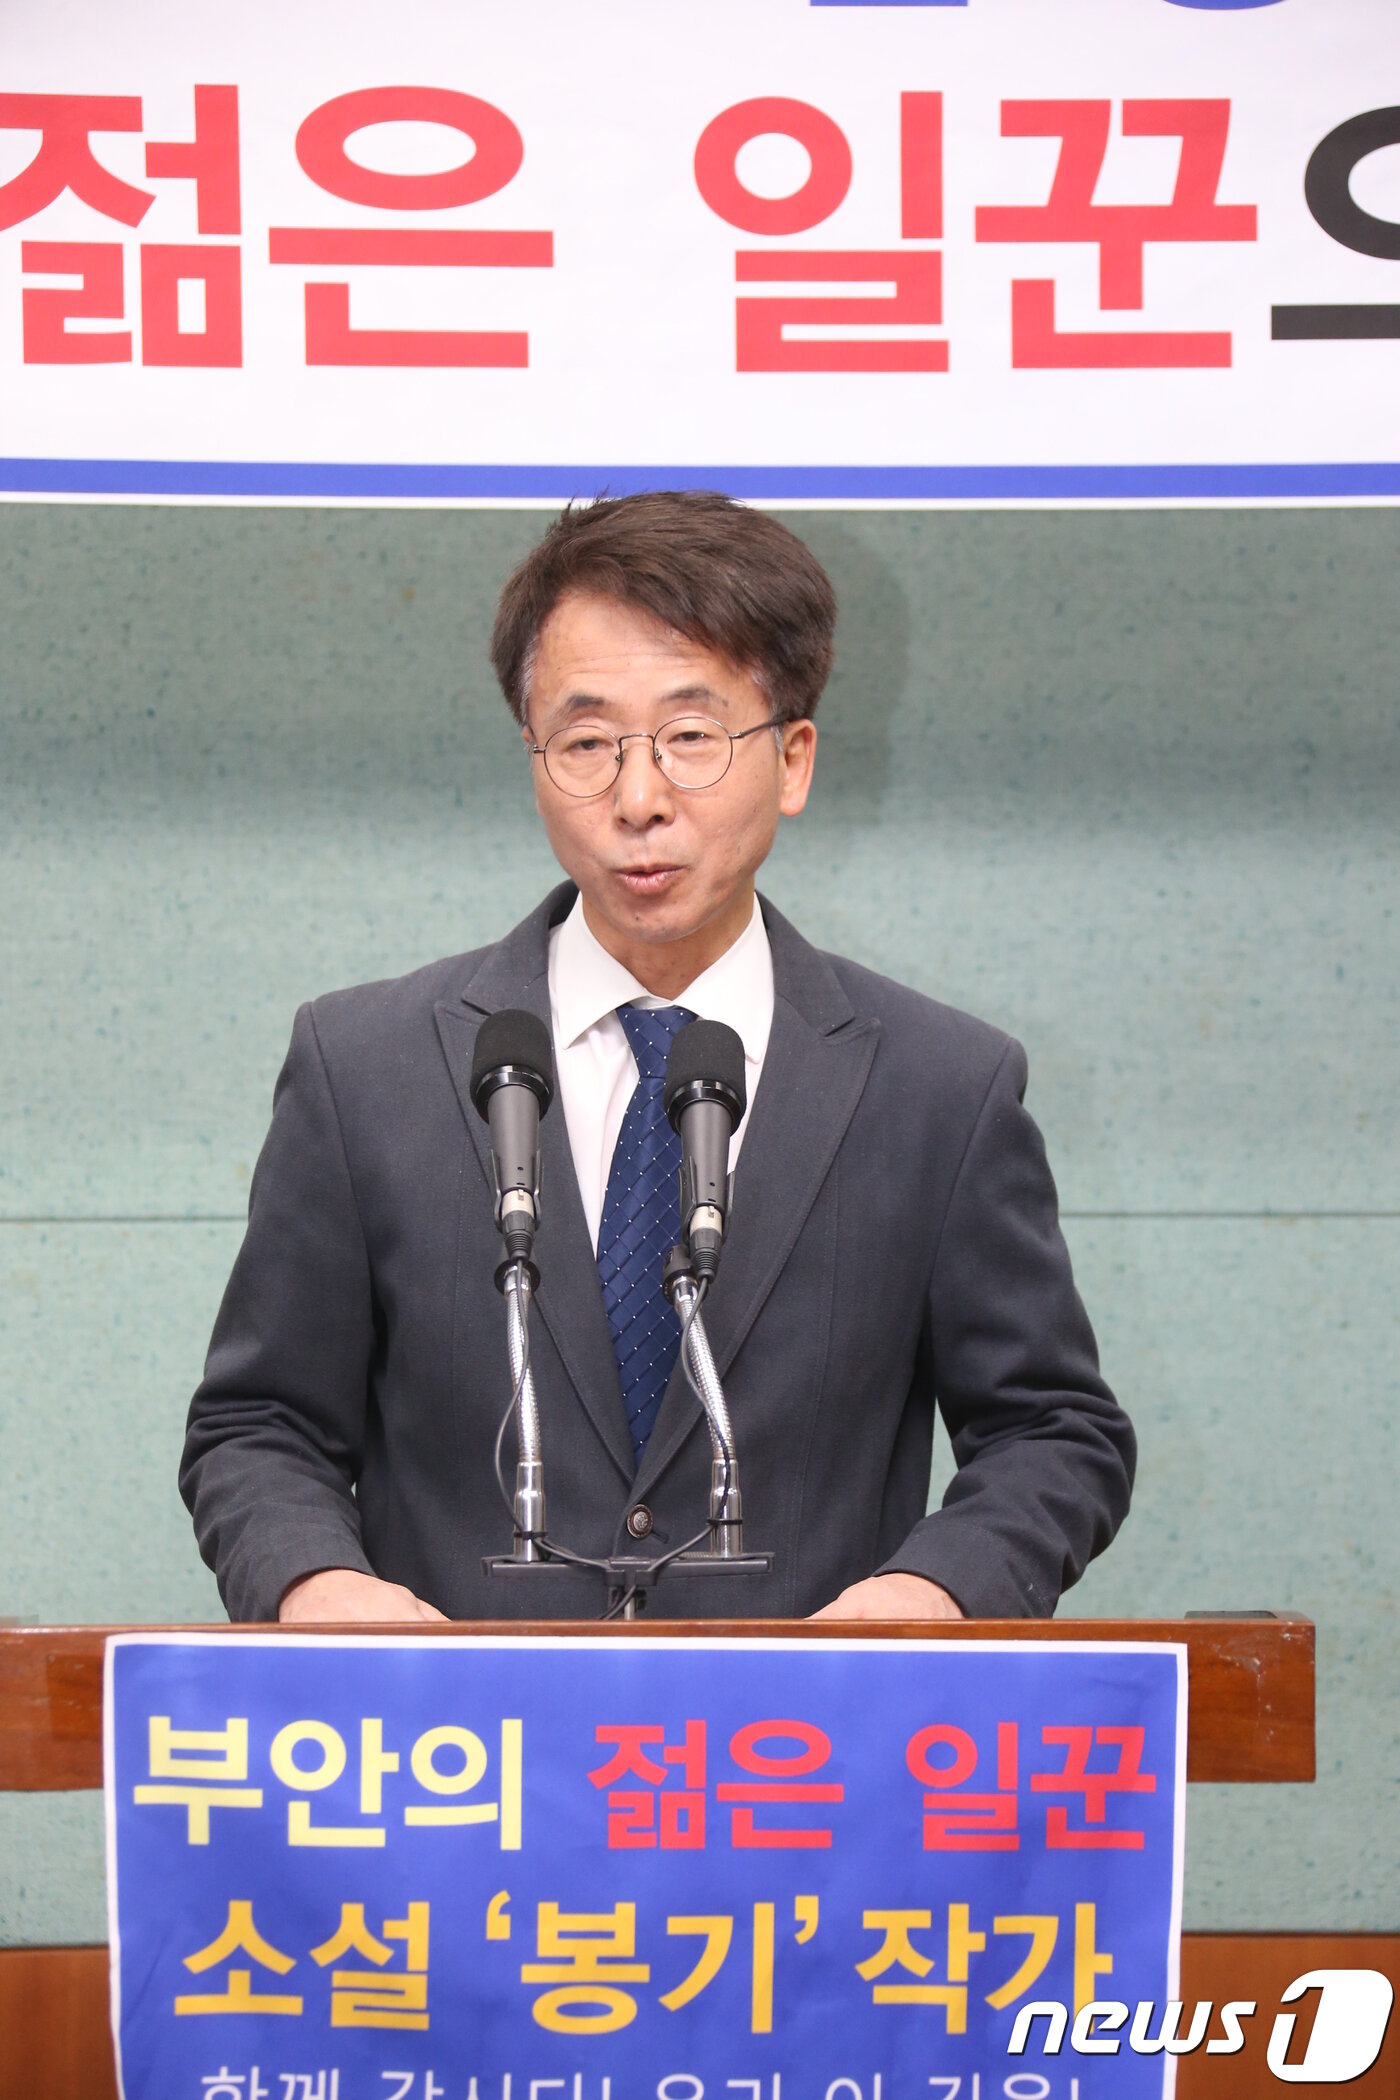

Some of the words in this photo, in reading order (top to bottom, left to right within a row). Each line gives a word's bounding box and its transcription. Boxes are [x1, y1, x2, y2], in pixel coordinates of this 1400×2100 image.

[0, 84, 554, 369] 젊은
[133, 1716, 523, 1851] 부안의
[587, 1719, 845, 1850] 젊은
[905, 1721, 1157, 1851] 일꾼
[174, 1900, 430, 2030] 소설
[854, 1902, 1113, 2035] 작가
